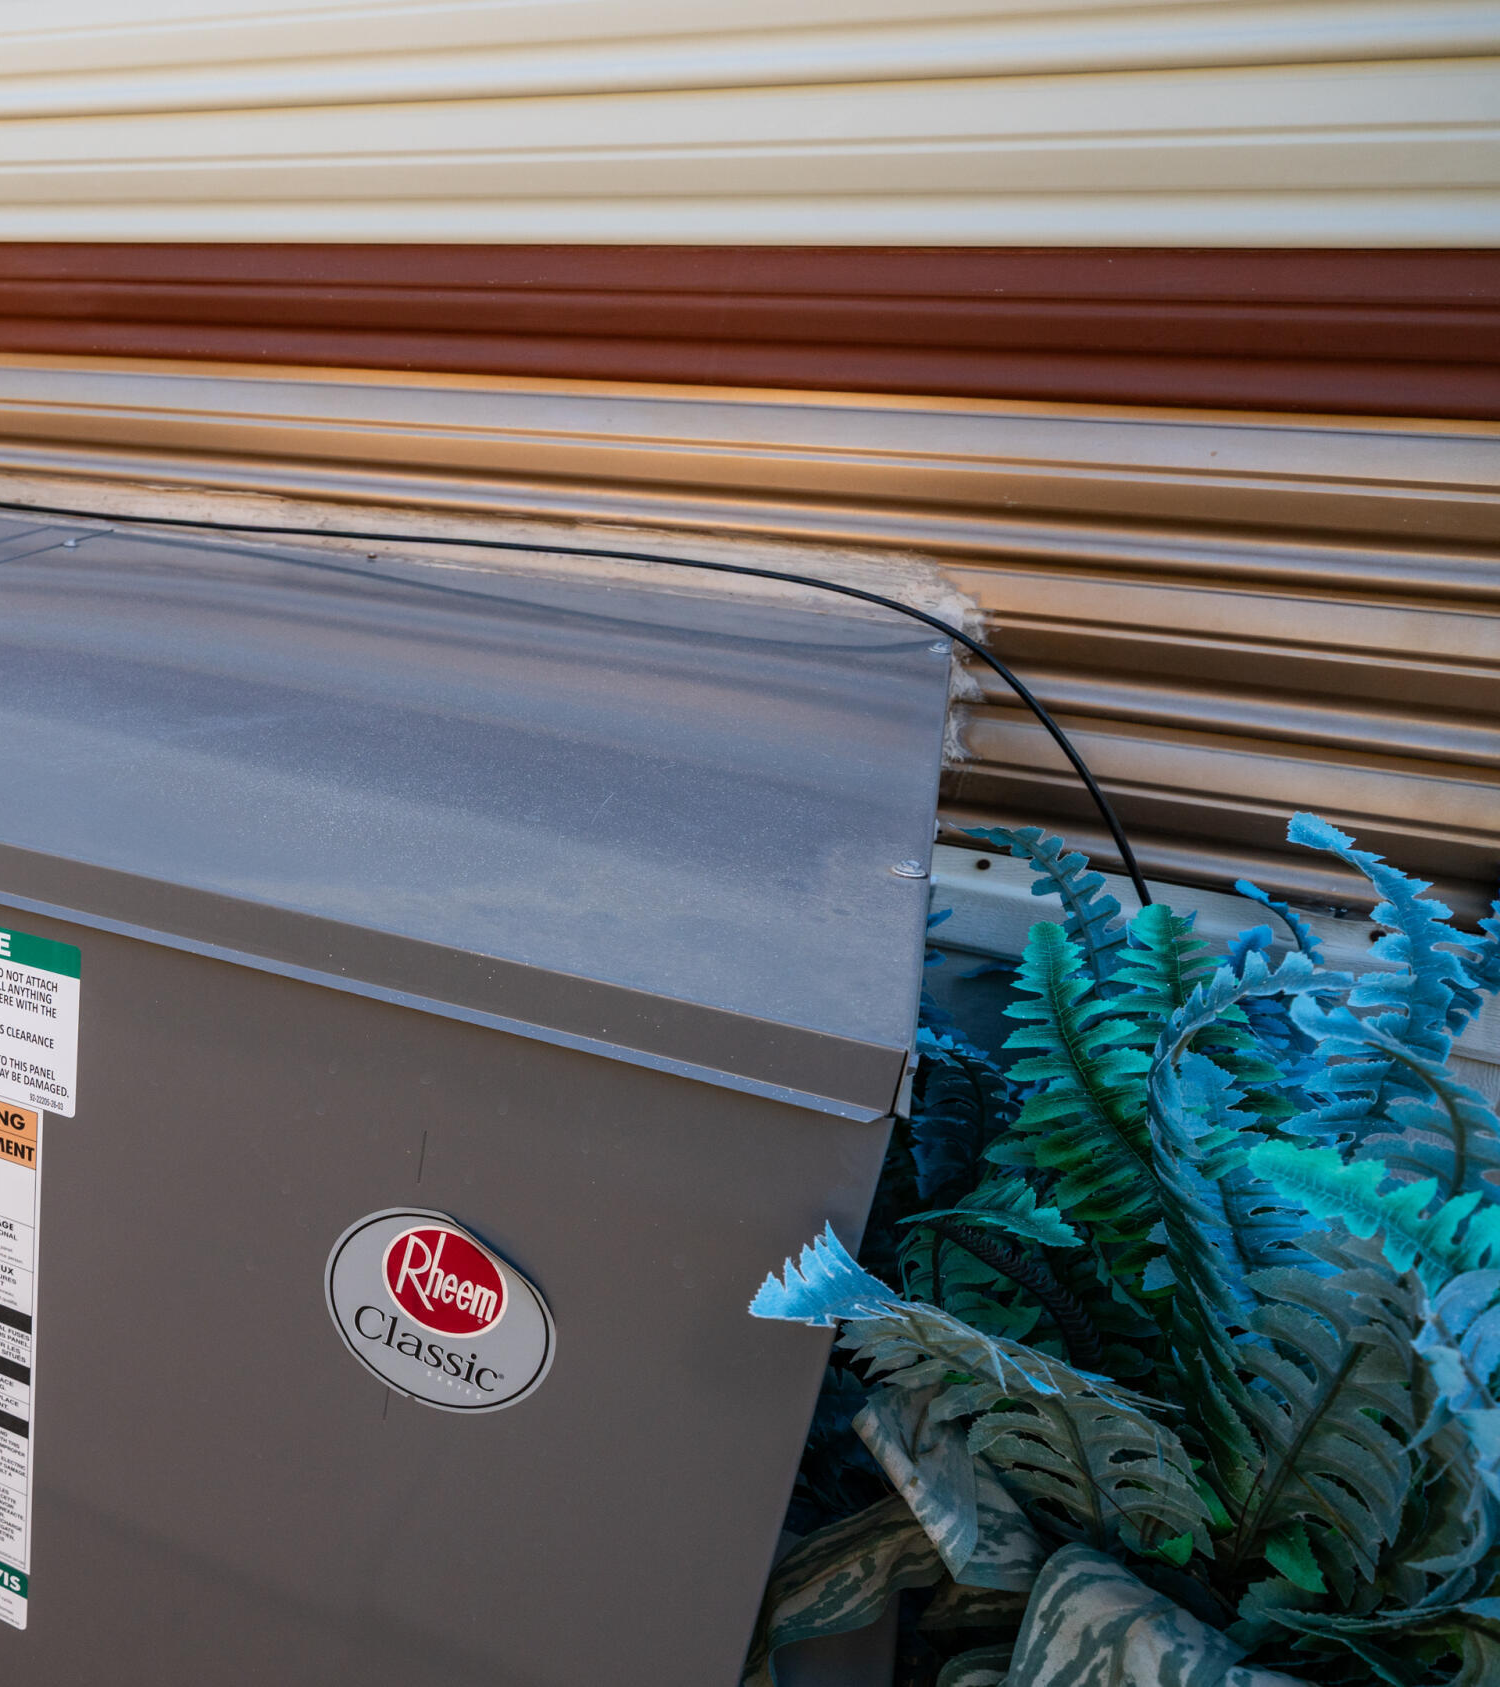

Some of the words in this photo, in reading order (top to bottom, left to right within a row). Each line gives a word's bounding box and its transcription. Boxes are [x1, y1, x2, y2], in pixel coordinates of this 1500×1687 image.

[5, 968, 23, 983] NOT
[25, 974, 57, 993] ATTACH
[7, 982, 52, 1004] ANYTHING
[15, 997, 38, 1013] WITH
[40, 1004, 56, 1018] THE
[6, 1025, 53, 1049] CLEARANCE
[9, 1057, 27, 1072] THIS
[29, 1063, 55, 1080] PANEL
[11, 1070, 21, 1083] BE
[23, 1073, 69, 1097] DAMAGED.
[395, 1232, 498, 1322] Rheem
[354, 1305, 498, 1392] Classic
